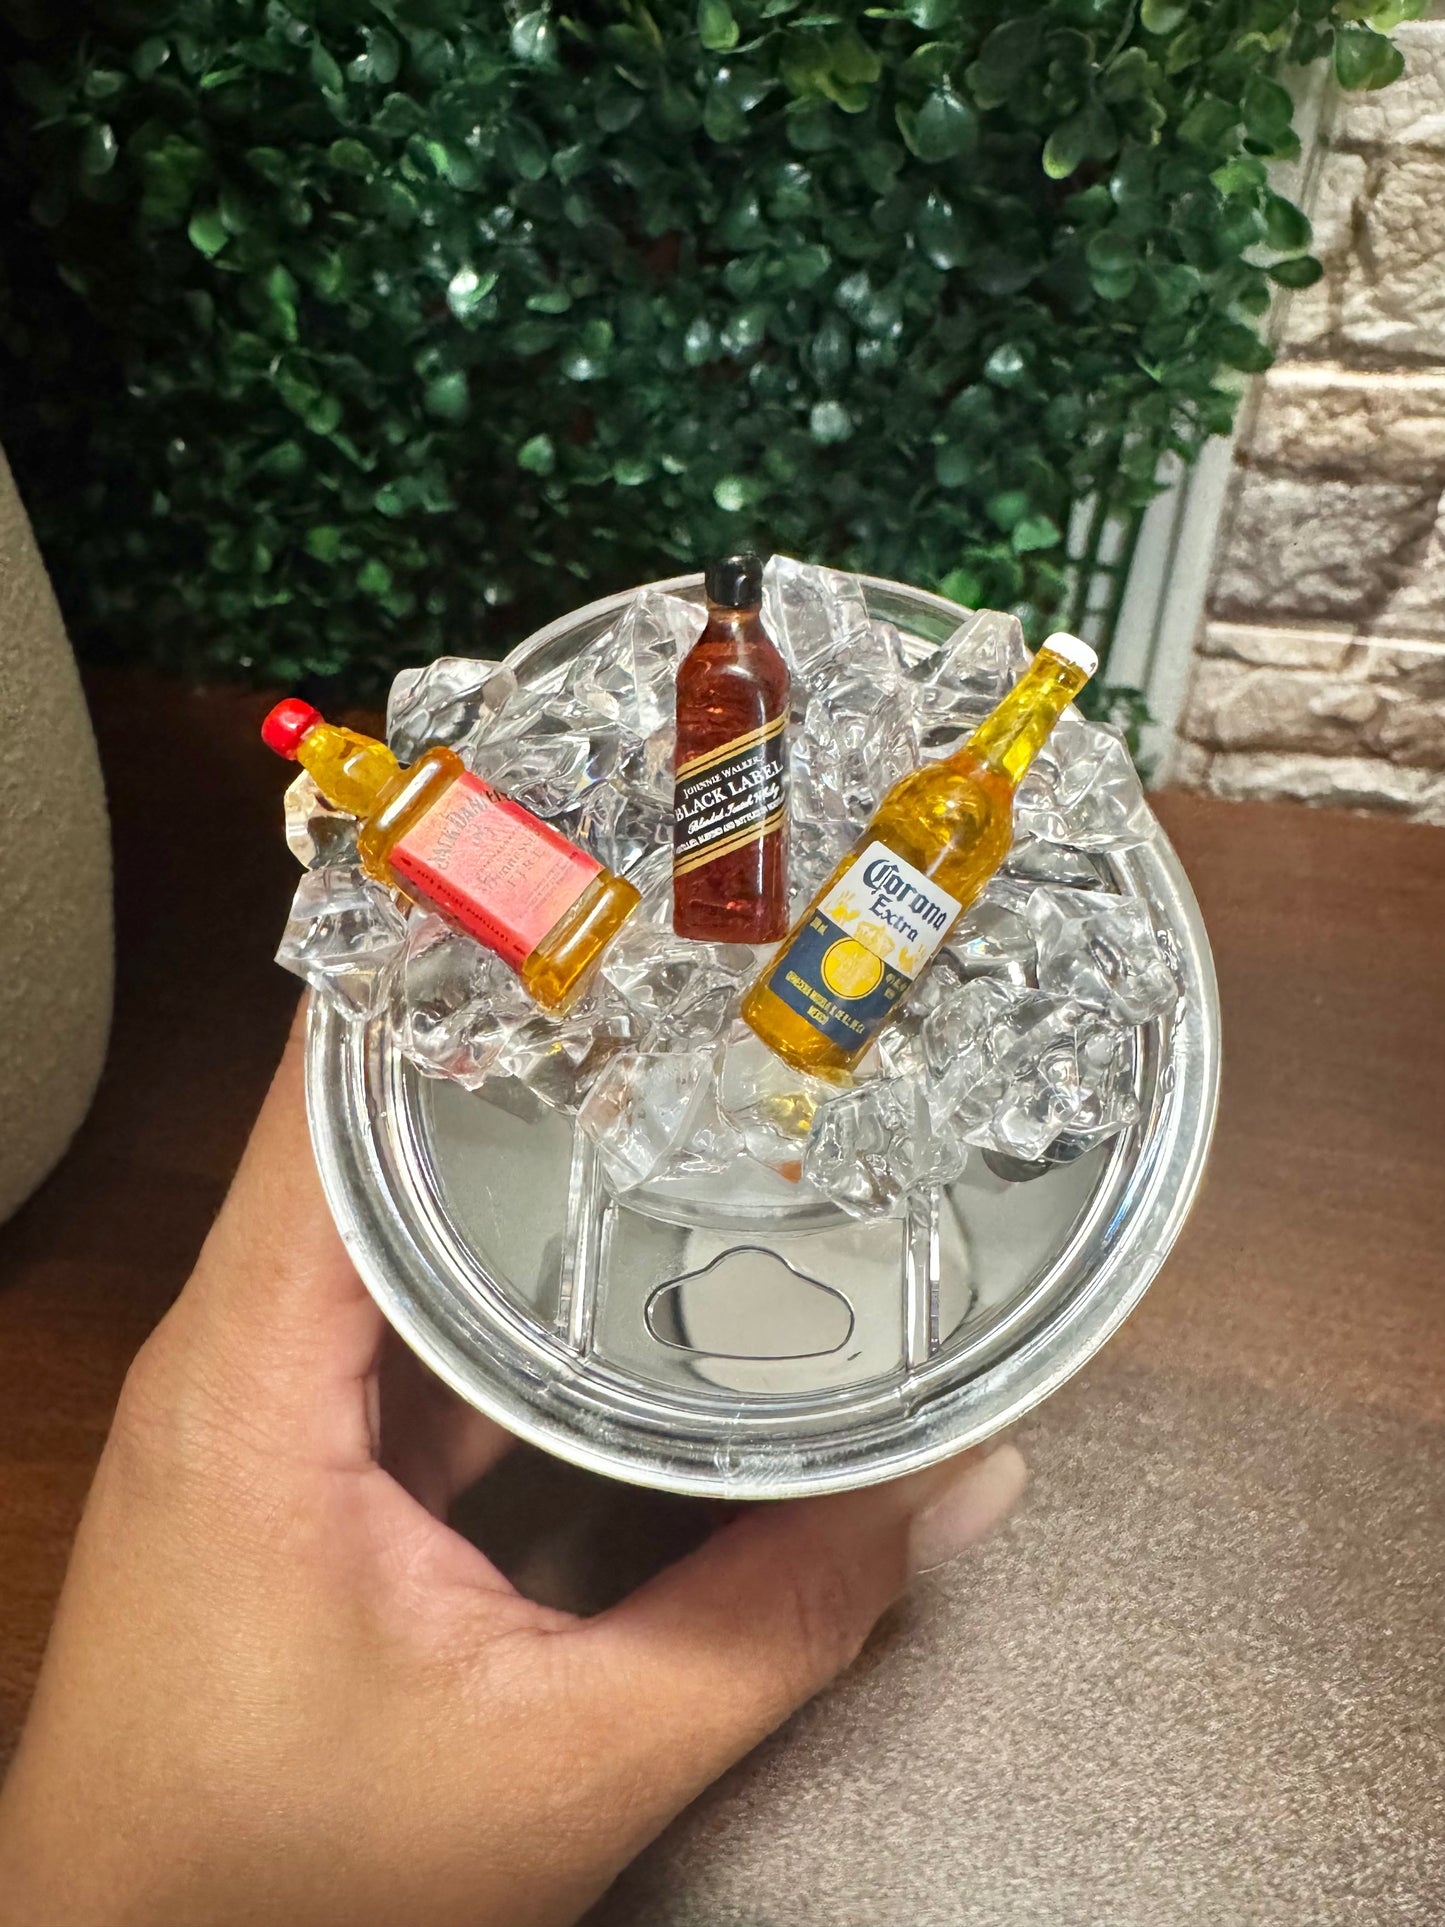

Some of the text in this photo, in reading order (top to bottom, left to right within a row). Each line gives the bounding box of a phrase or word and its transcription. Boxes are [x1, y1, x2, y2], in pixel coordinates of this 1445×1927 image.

[675, 788, 728, 822] BLACK
[730, 760, 784, 796] LABEL
[683, 773, 722, 800] JOHNNIE
[862, 858, 948, 932] Corona
[868, 893, 918, 943] Extra
